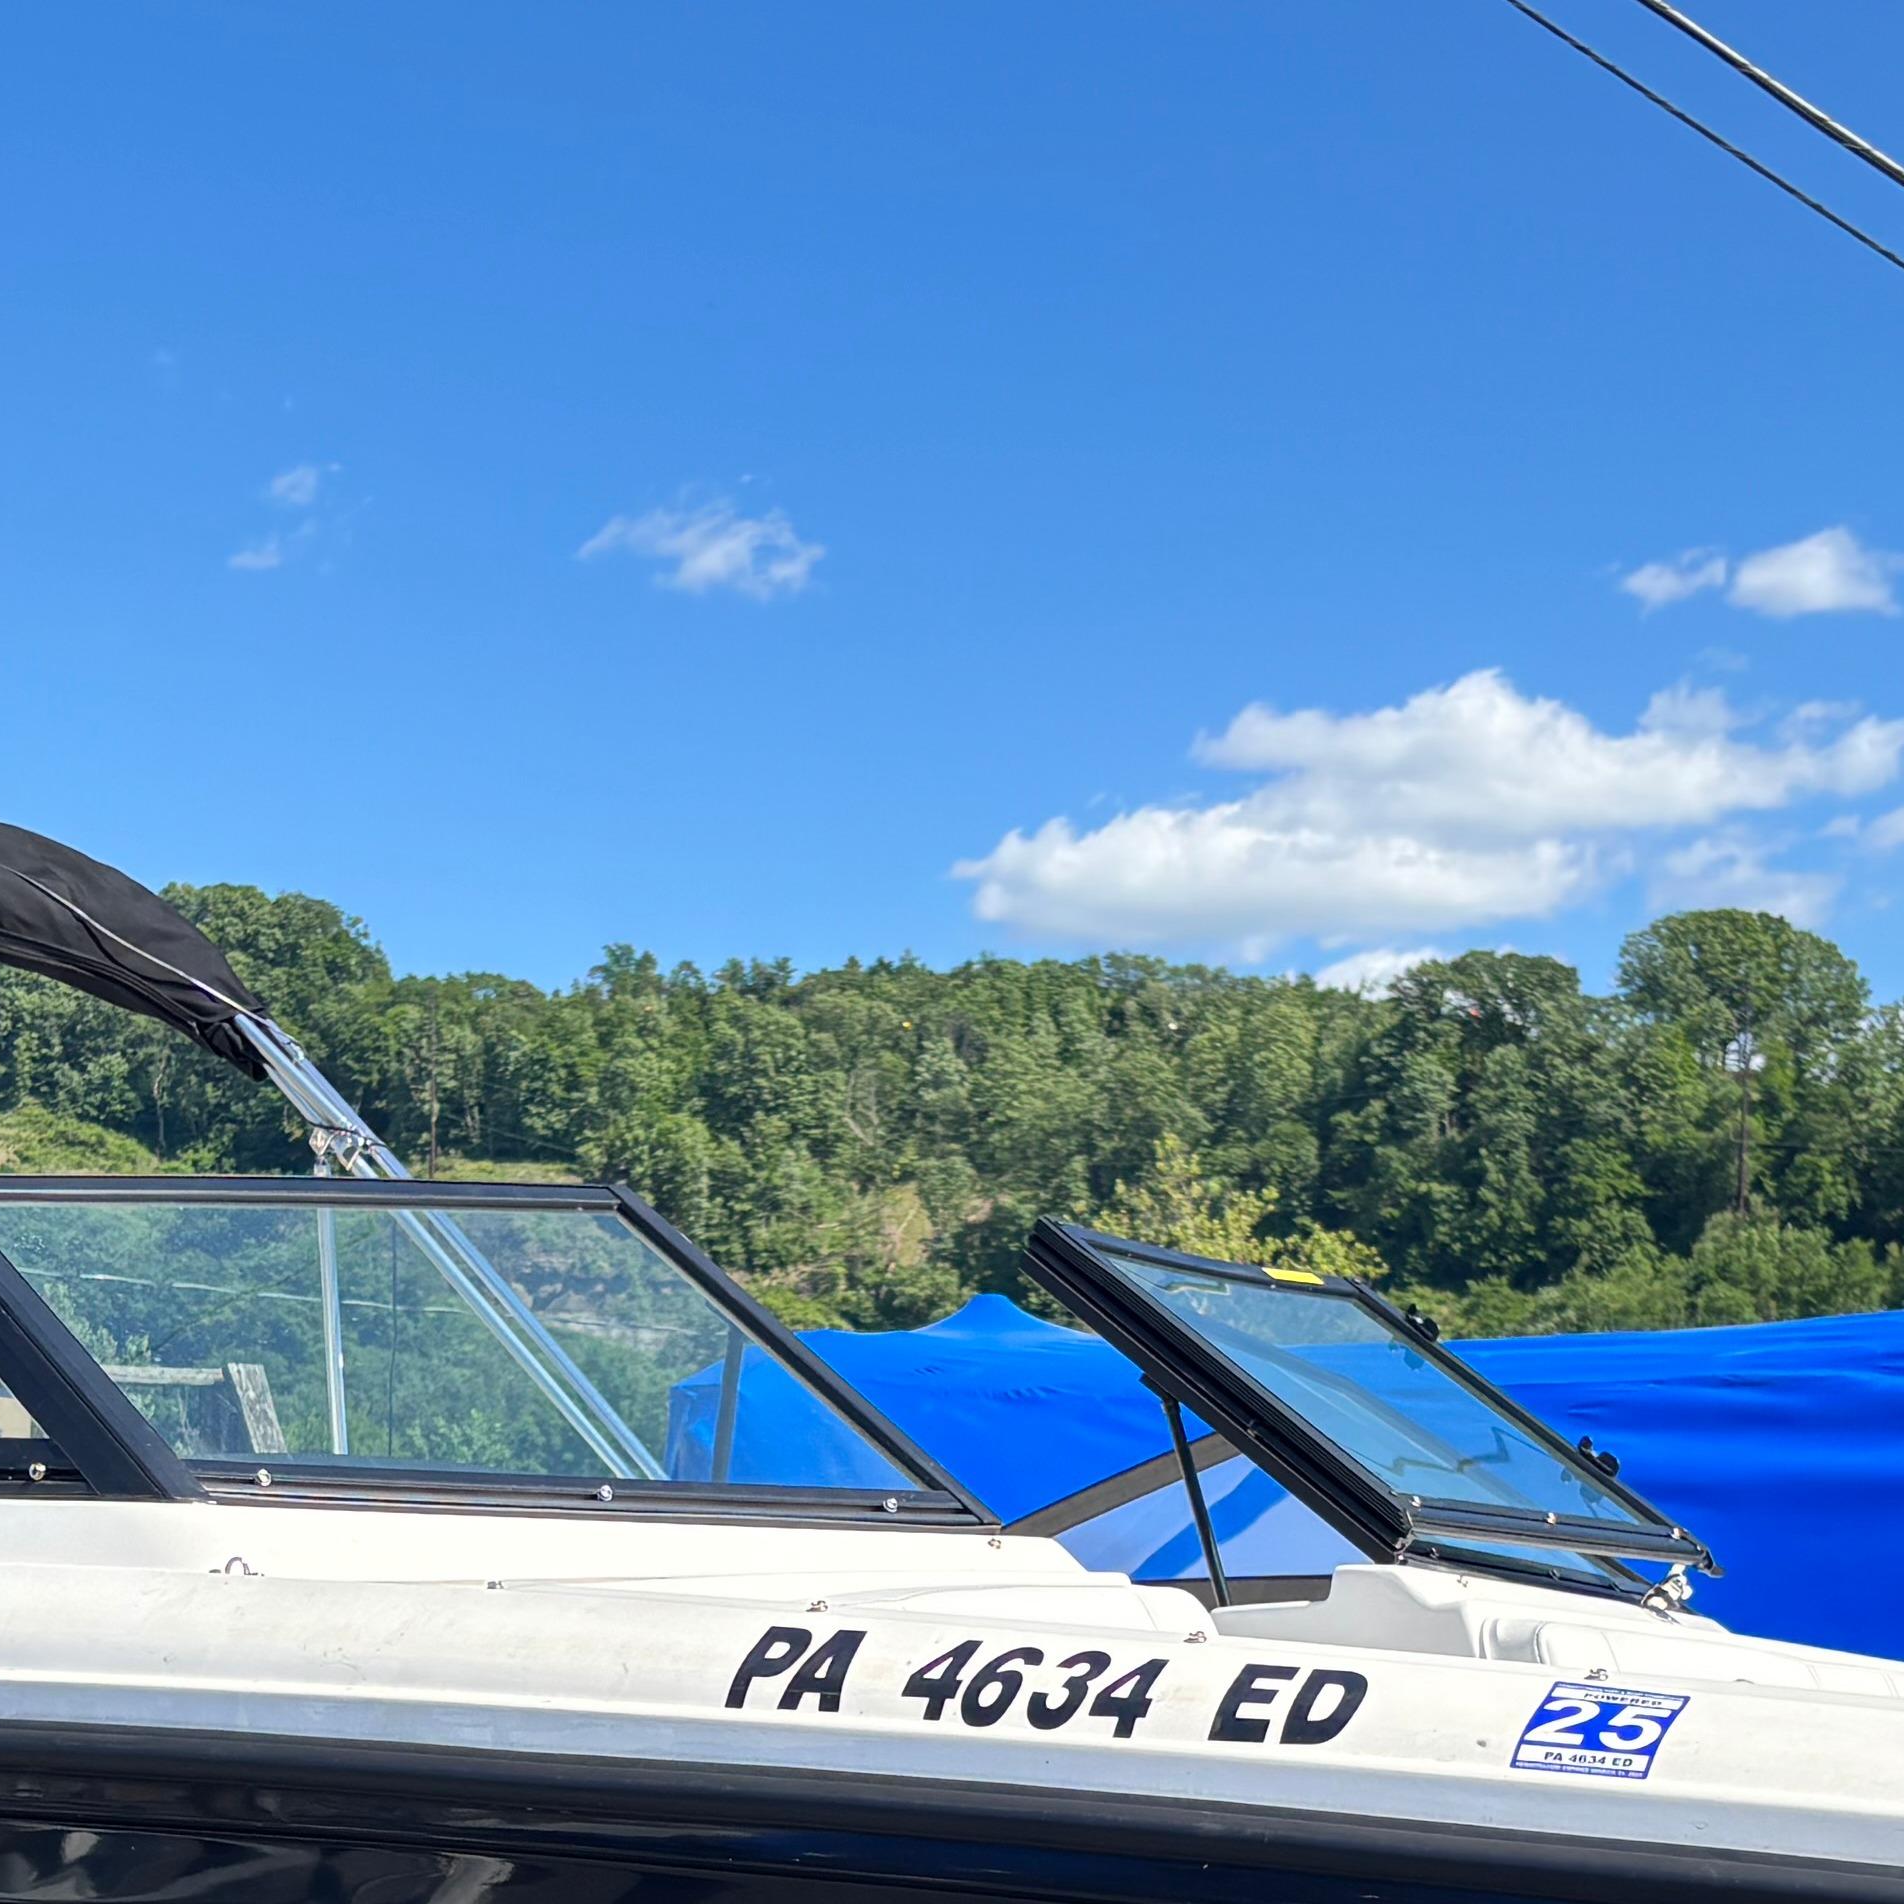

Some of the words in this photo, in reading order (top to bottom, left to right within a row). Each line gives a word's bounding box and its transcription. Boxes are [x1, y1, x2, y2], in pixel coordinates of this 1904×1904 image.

[725, 1626, 867, 1712] PA
[902, 1638, 1170, 1739] 4634
[1208, 1663, 1368, 1745] ED
[1523, 1699, 1672, 1751] 25
[1544, 1751, 1563, 1762] PA
[1568, 1753, 1607, 1766] 4634
[1612, 1756, 1633, 1767] ED
